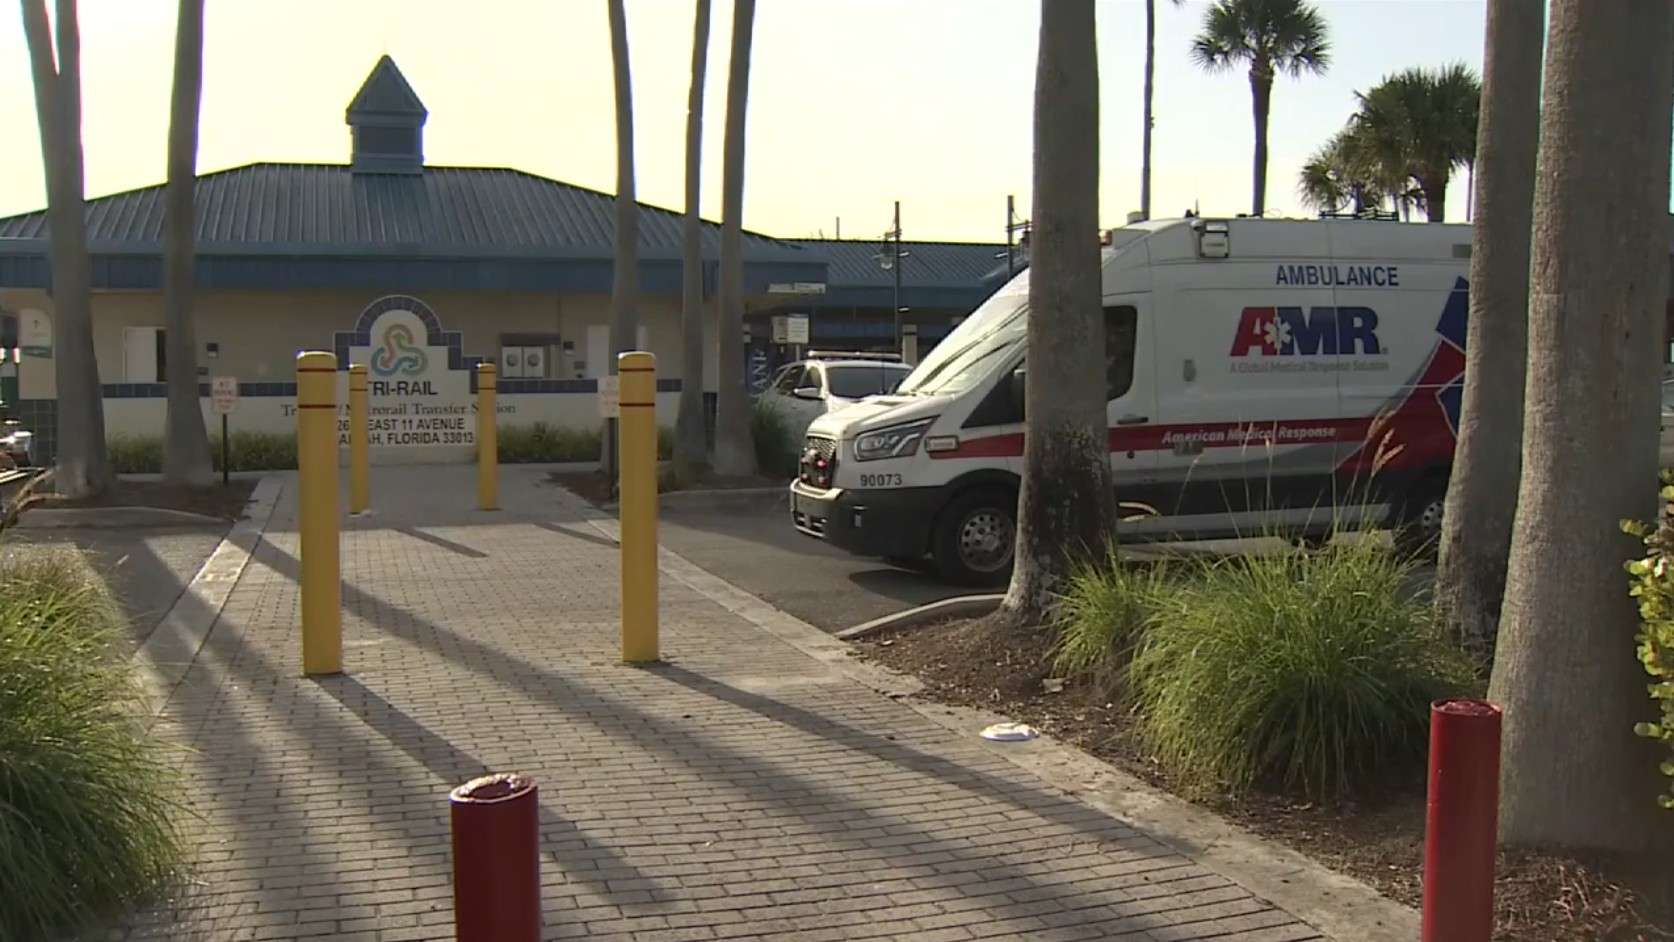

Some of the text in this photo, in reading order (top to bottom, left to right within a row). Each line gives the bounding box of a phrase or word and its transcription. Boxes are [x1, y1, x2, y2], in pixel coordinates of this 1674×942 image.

[1276, 265, 1399, 286] AMBULANCE
[1230, 306, 1381, 357] AMR
[412, 403, 466, 418] Transfer
[401, 418, 414, 431] 11
[416, 418, 465, 431] AVENUE
[387, 431, 440, 445] FLORIDA
[442, 431, 474, 444] 33013
[1162, 428, 1225, 445] American
[1277, 425, 1337, 441] Response
[860, 473, 903, 487] 90073
